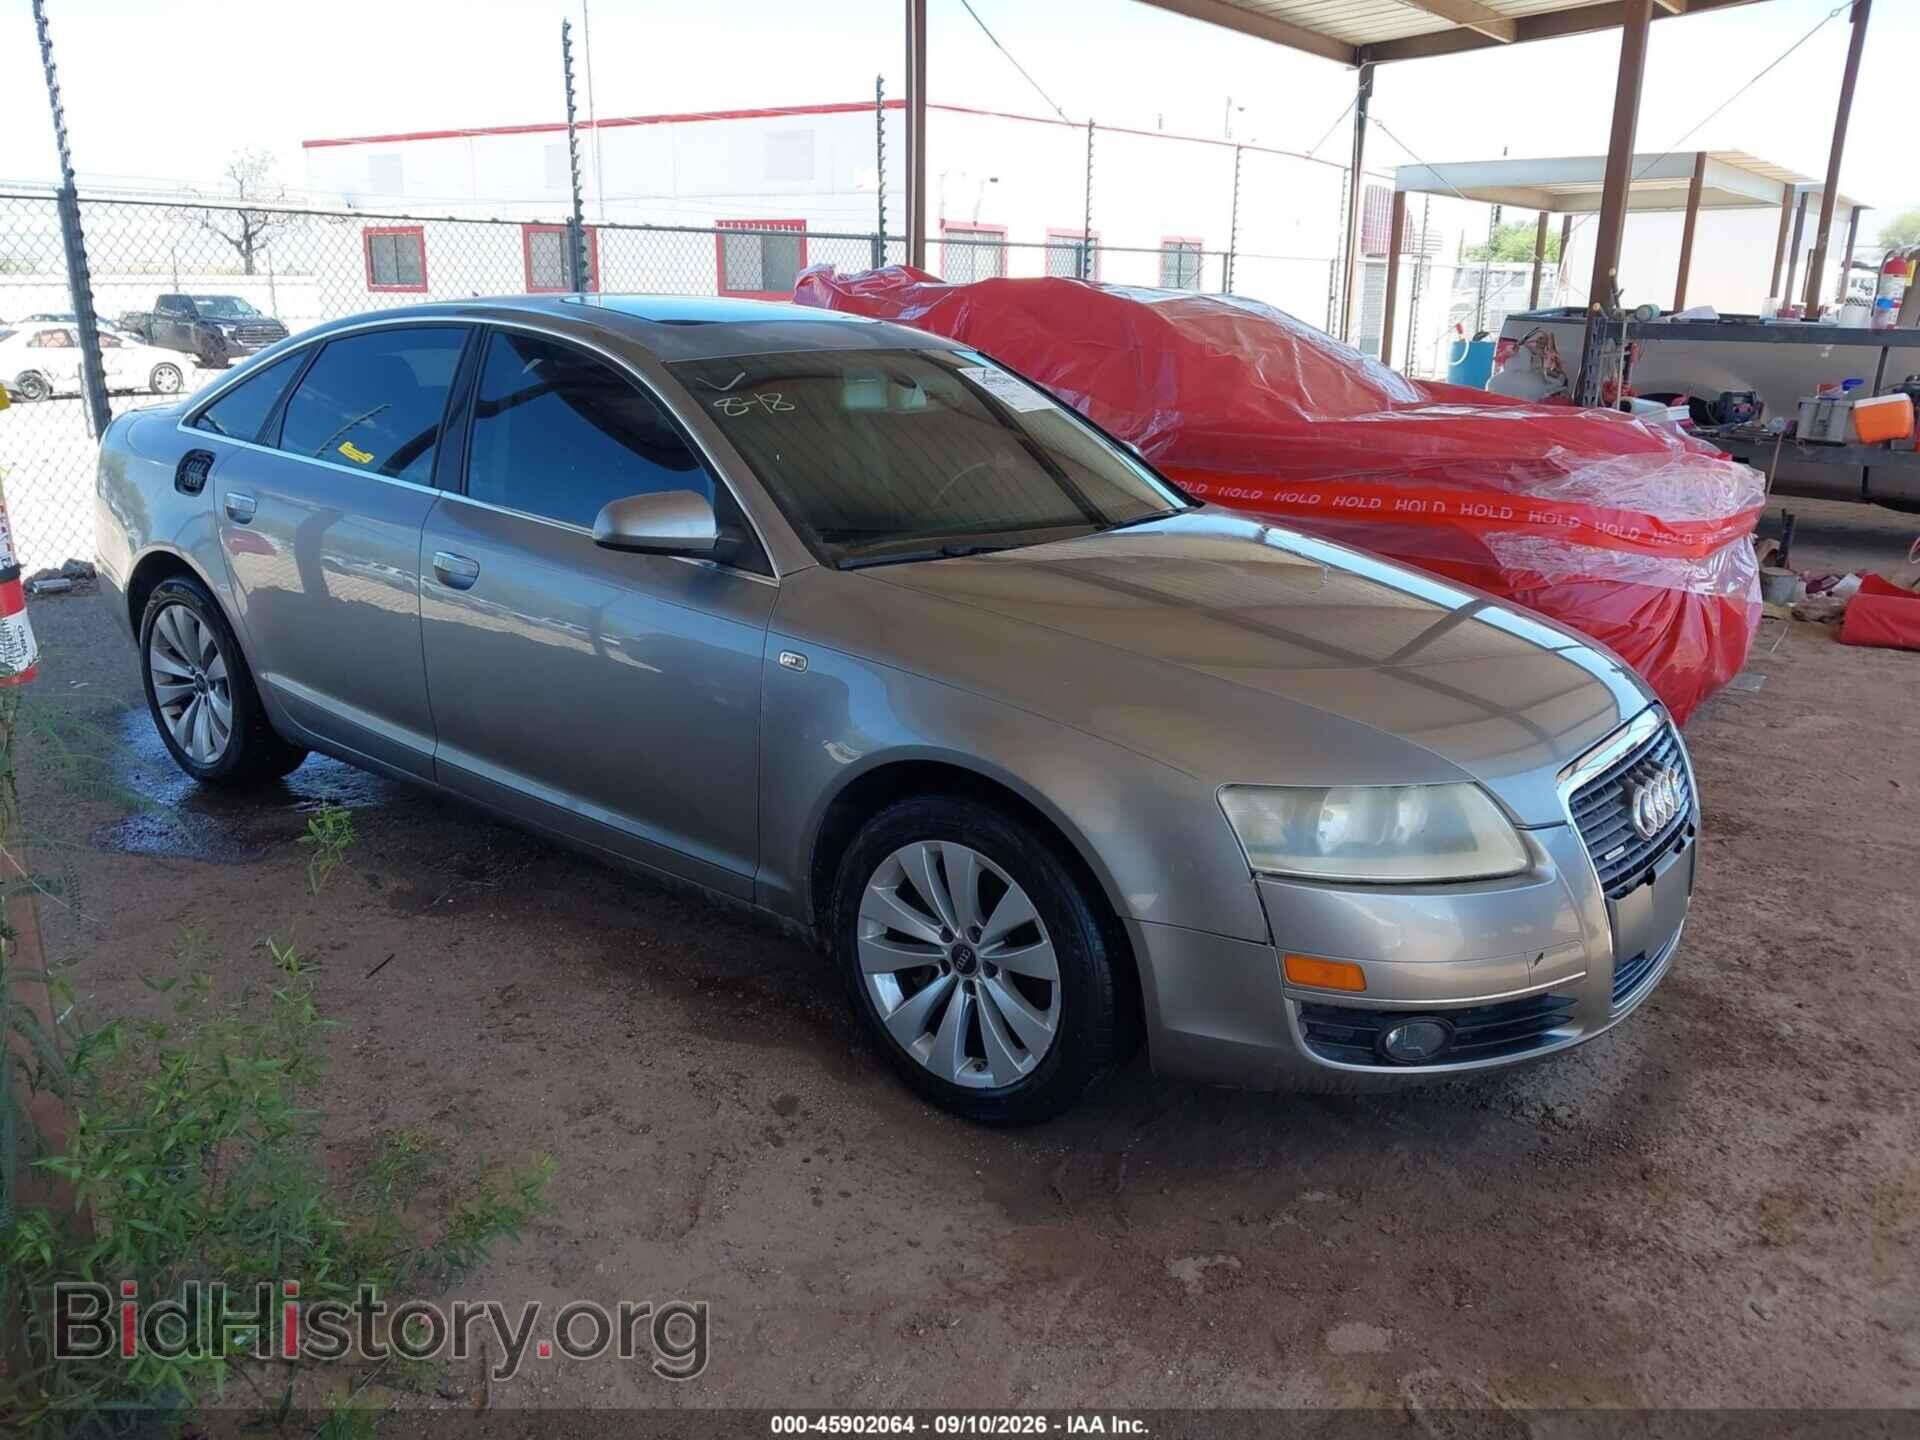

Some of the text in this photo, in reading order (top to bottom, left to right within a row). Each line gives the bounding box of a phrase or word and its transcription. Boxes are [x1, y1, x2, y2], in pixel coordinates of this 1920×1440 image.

[1173, 480, 1208, 494] OLD
[1217, 486, 1263, 500] HOLD
[1273, 491, 1321, 505] HOLD
[1332, 495, 1382, 509] HOLD
[1459, 502, 1513, 520] HOLD
[1528, 510, 1583, 529] HOLD
[1595, 522, 1641, 541] HOLD
